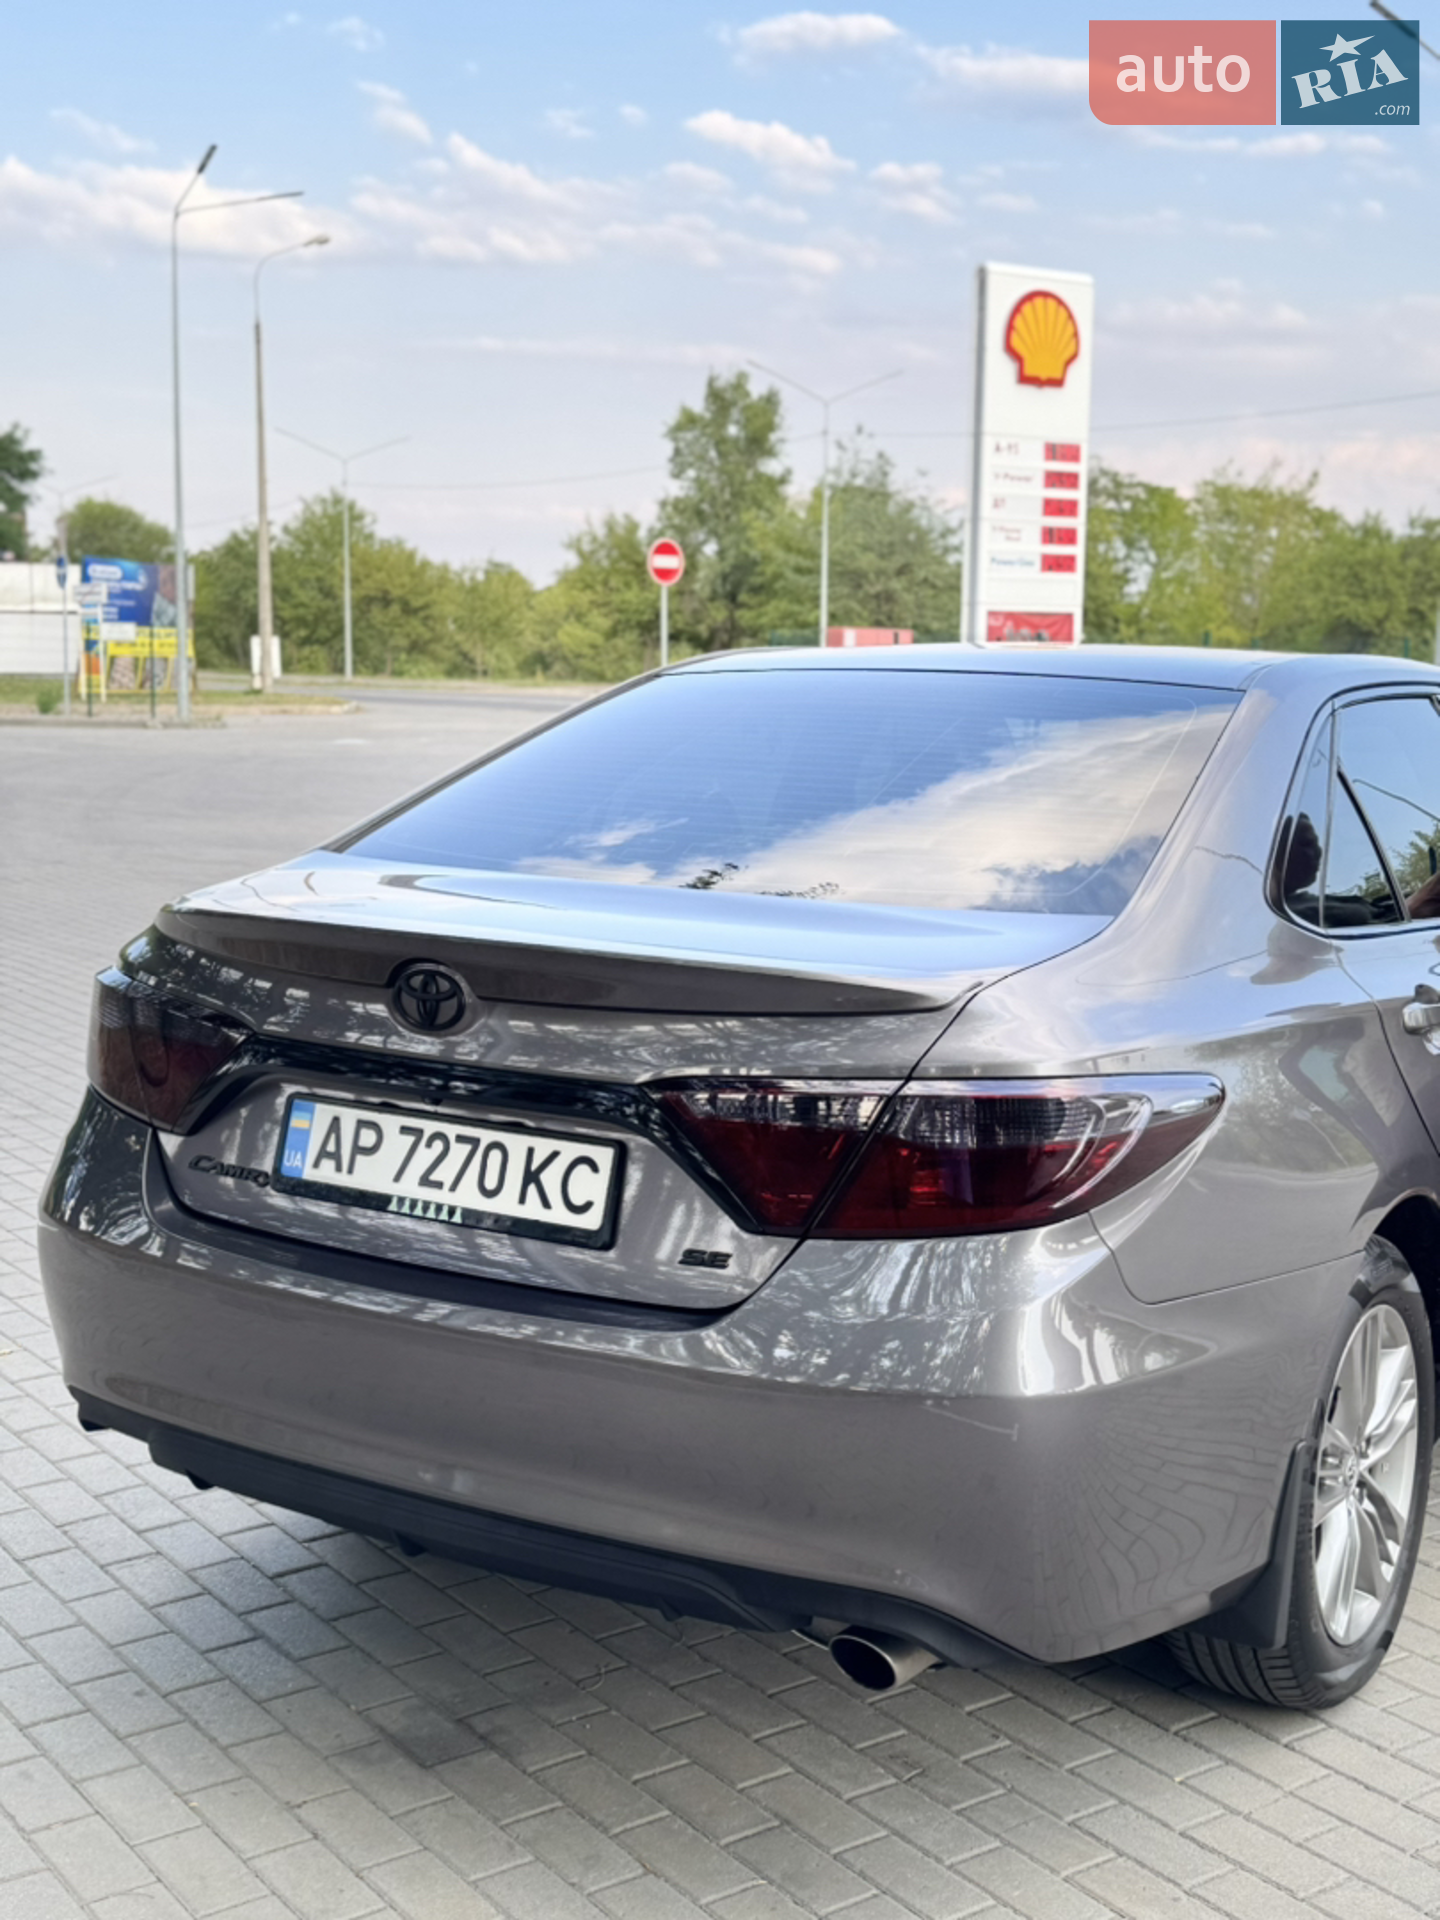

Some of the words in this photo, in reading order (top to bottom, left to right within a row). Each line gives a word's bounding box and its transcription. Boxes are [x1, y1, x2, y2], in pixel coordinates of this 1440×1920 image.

[284, 1148, 304, 1168] UA
[392, 1125, 510, 1199] 7270
[678, 1248, 733, 1270] SE
